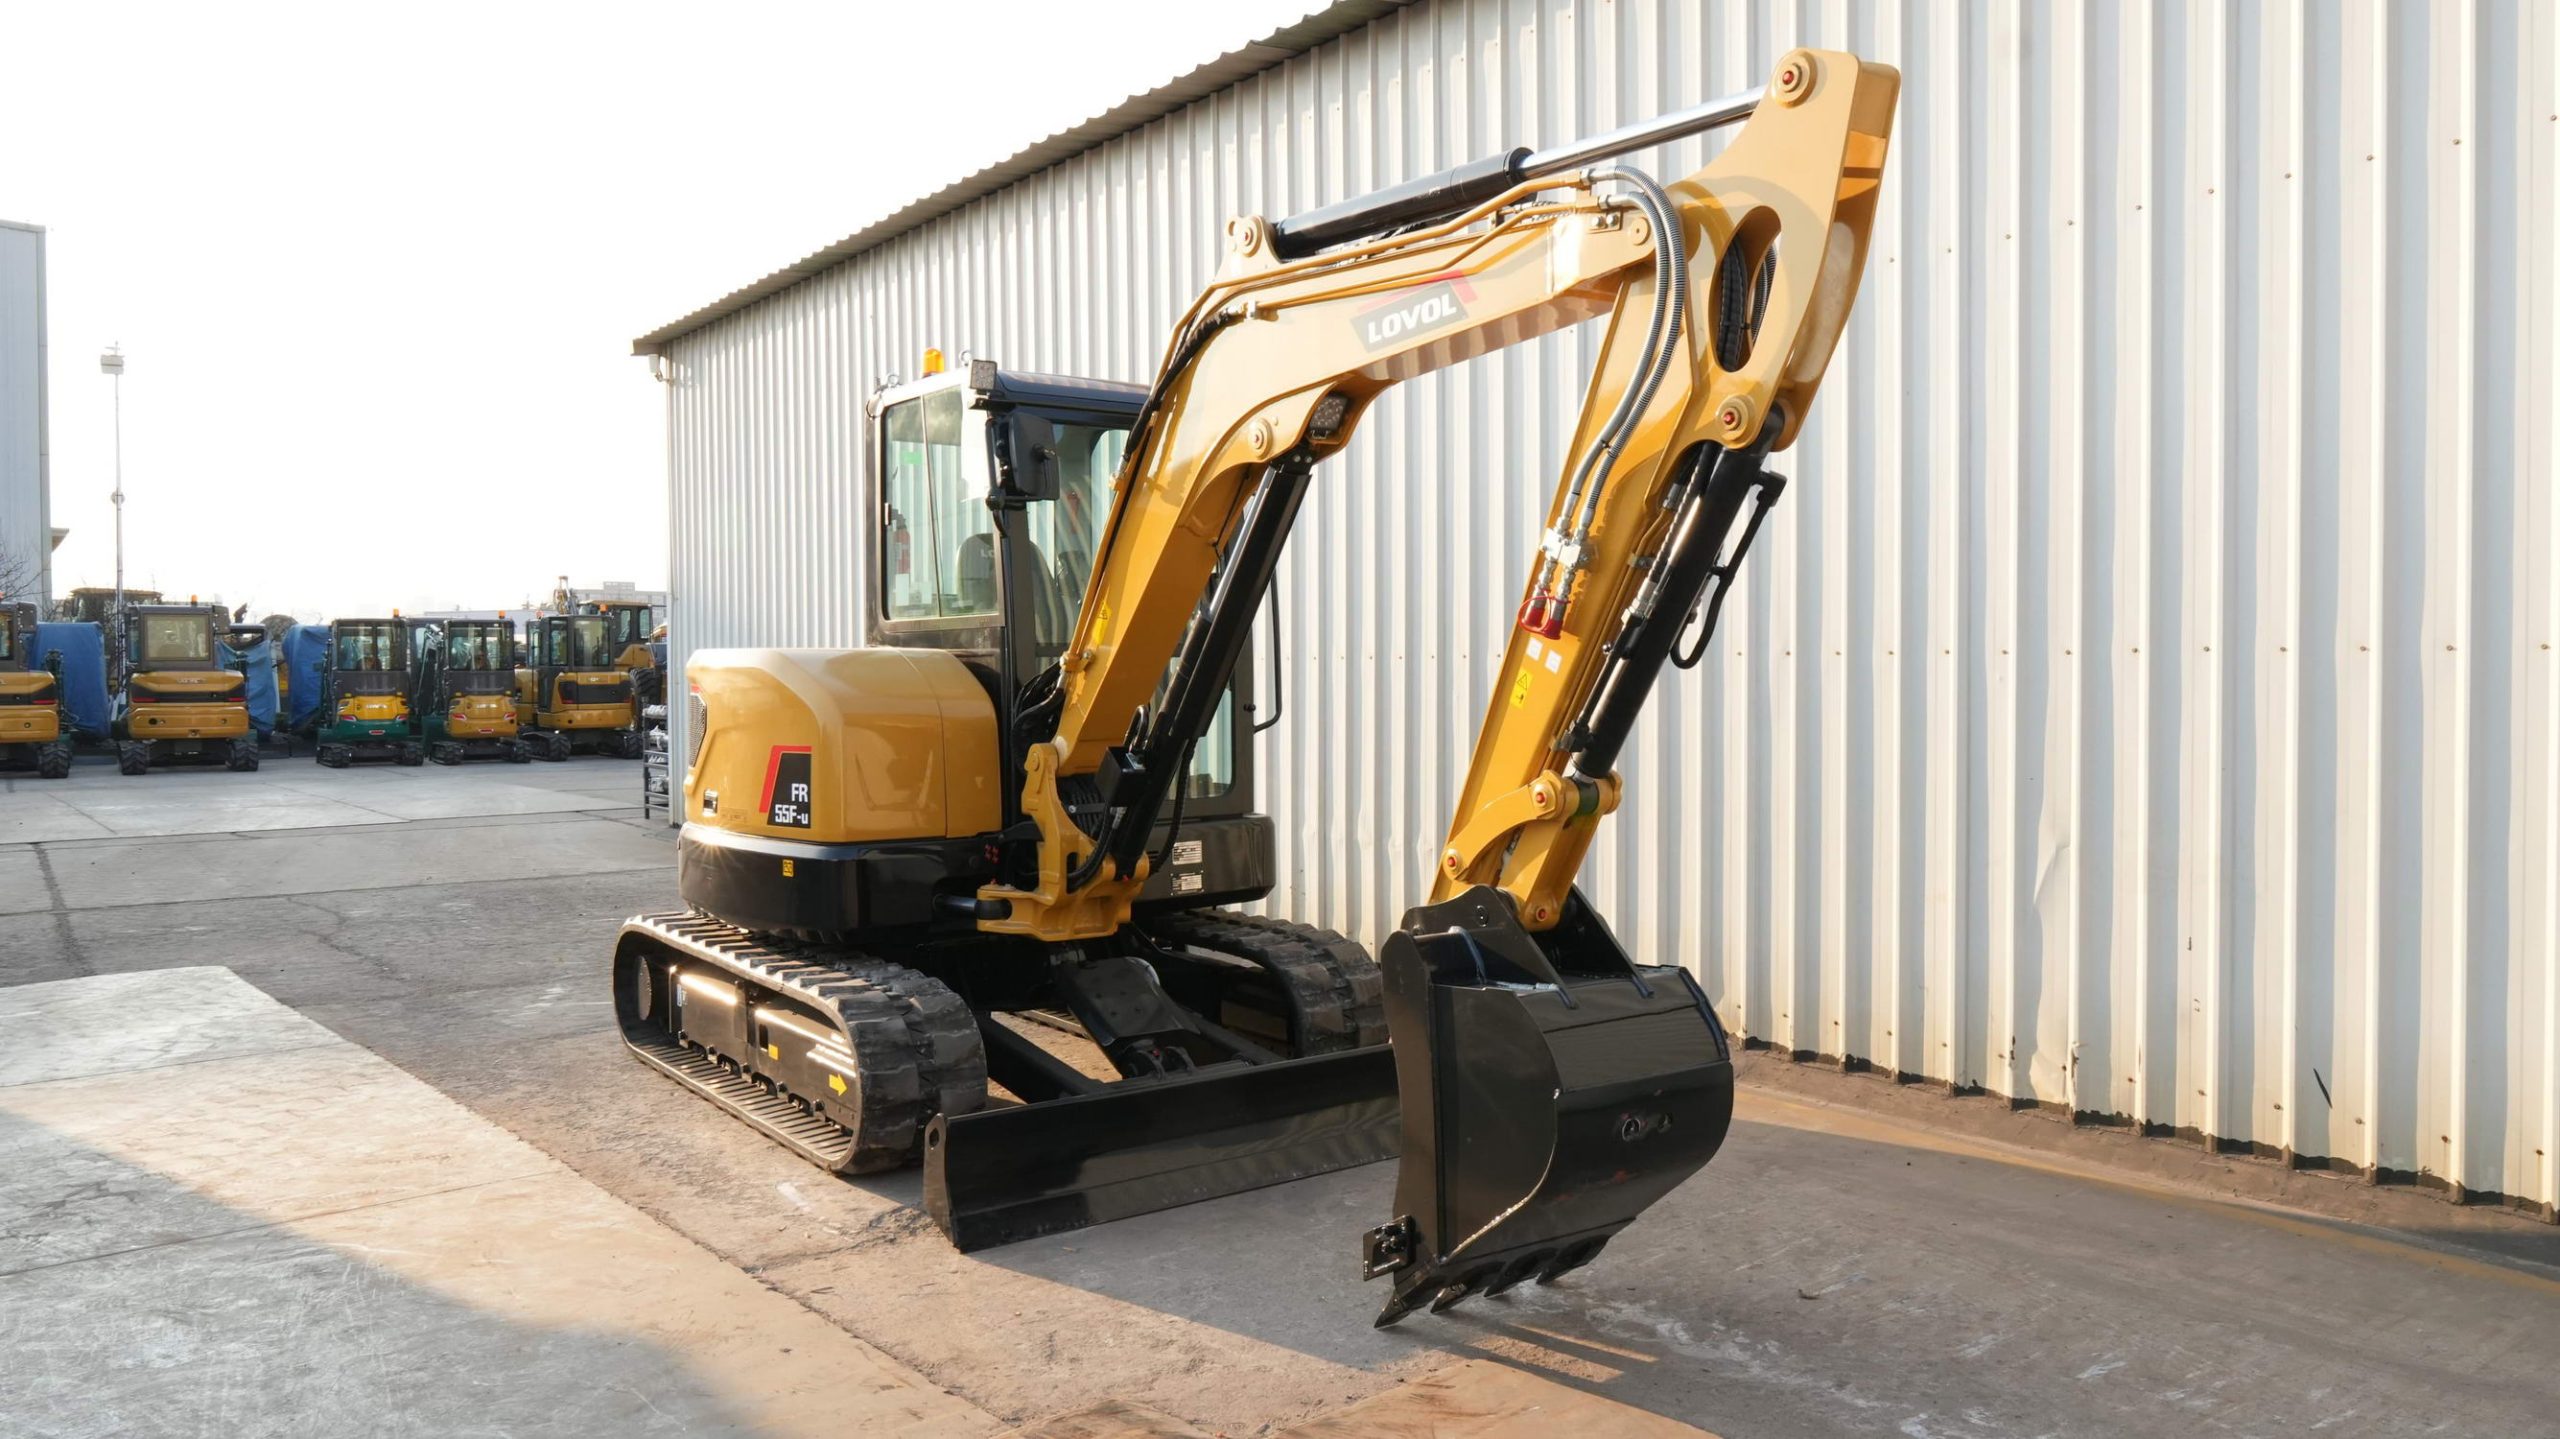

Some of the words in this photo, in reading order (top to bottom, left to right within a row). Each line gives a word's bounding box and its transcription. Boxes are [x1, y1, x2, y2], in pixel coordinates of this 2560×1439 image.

[1368, 293, 1457, 344] LOVOL
[791, 783, 808, 802] FR
[774, 804, 808, 824] 55F-u
